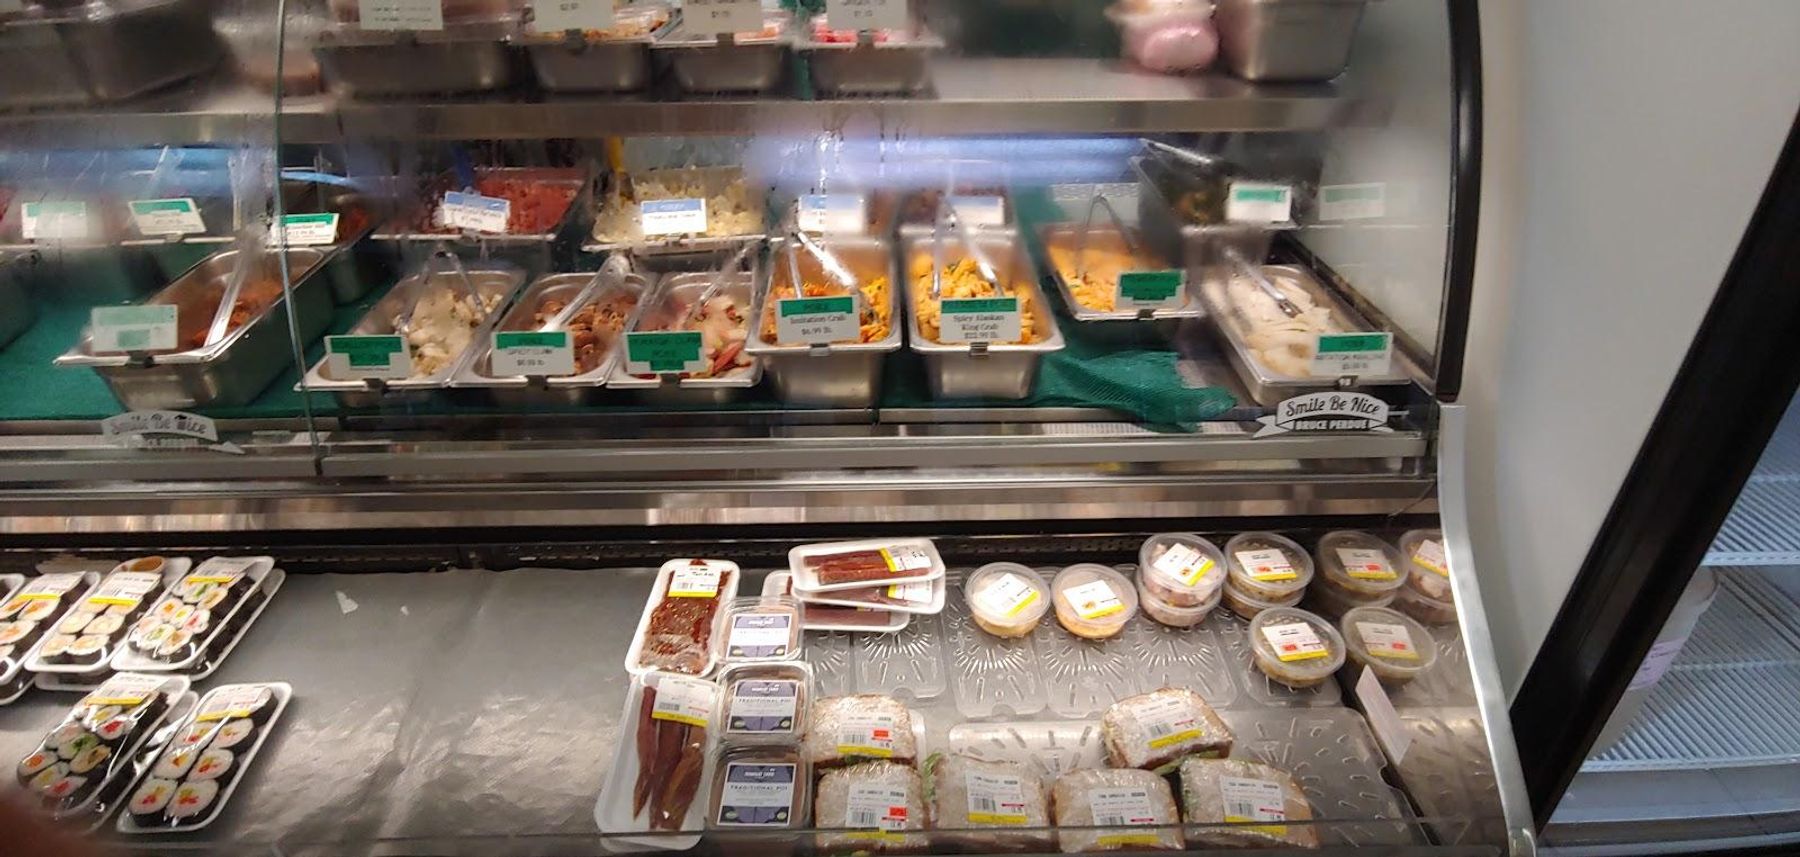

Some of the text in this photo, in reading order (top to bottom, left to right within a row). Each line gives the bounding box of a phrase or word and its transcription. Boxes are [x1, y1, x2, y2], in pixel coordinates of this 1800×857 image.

[1286, 394, 1381, 418] Smile Be Nice
[1295, 419, 1369, 430] BRUCE PERDUE
